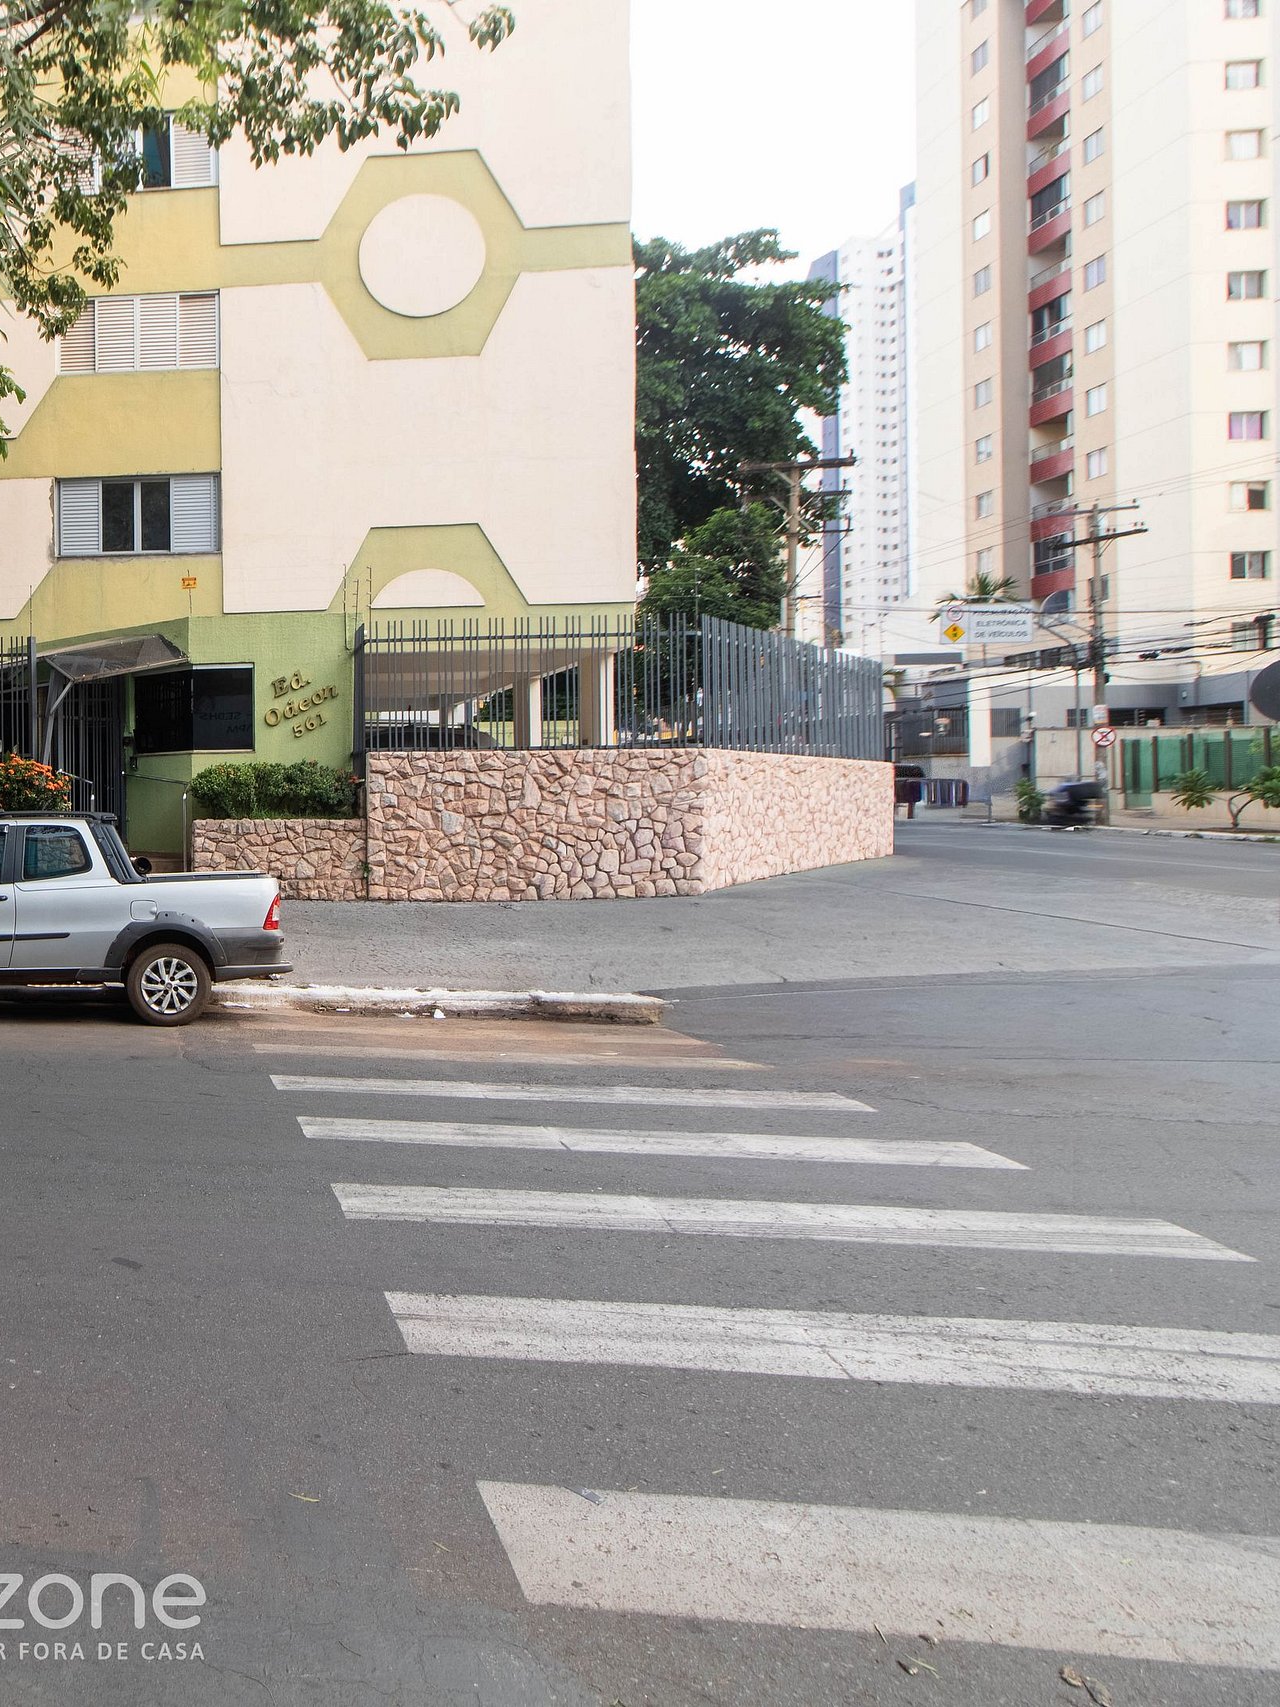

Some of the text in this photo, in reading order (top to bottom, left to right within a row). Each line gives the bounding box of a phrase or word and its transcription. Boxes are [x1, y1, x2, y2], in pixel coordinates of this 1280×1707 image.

[271, 670, 311, 699] Ed.
[264, 684, 339, 727] Odeon
[292, 712, 327, 738] 561
